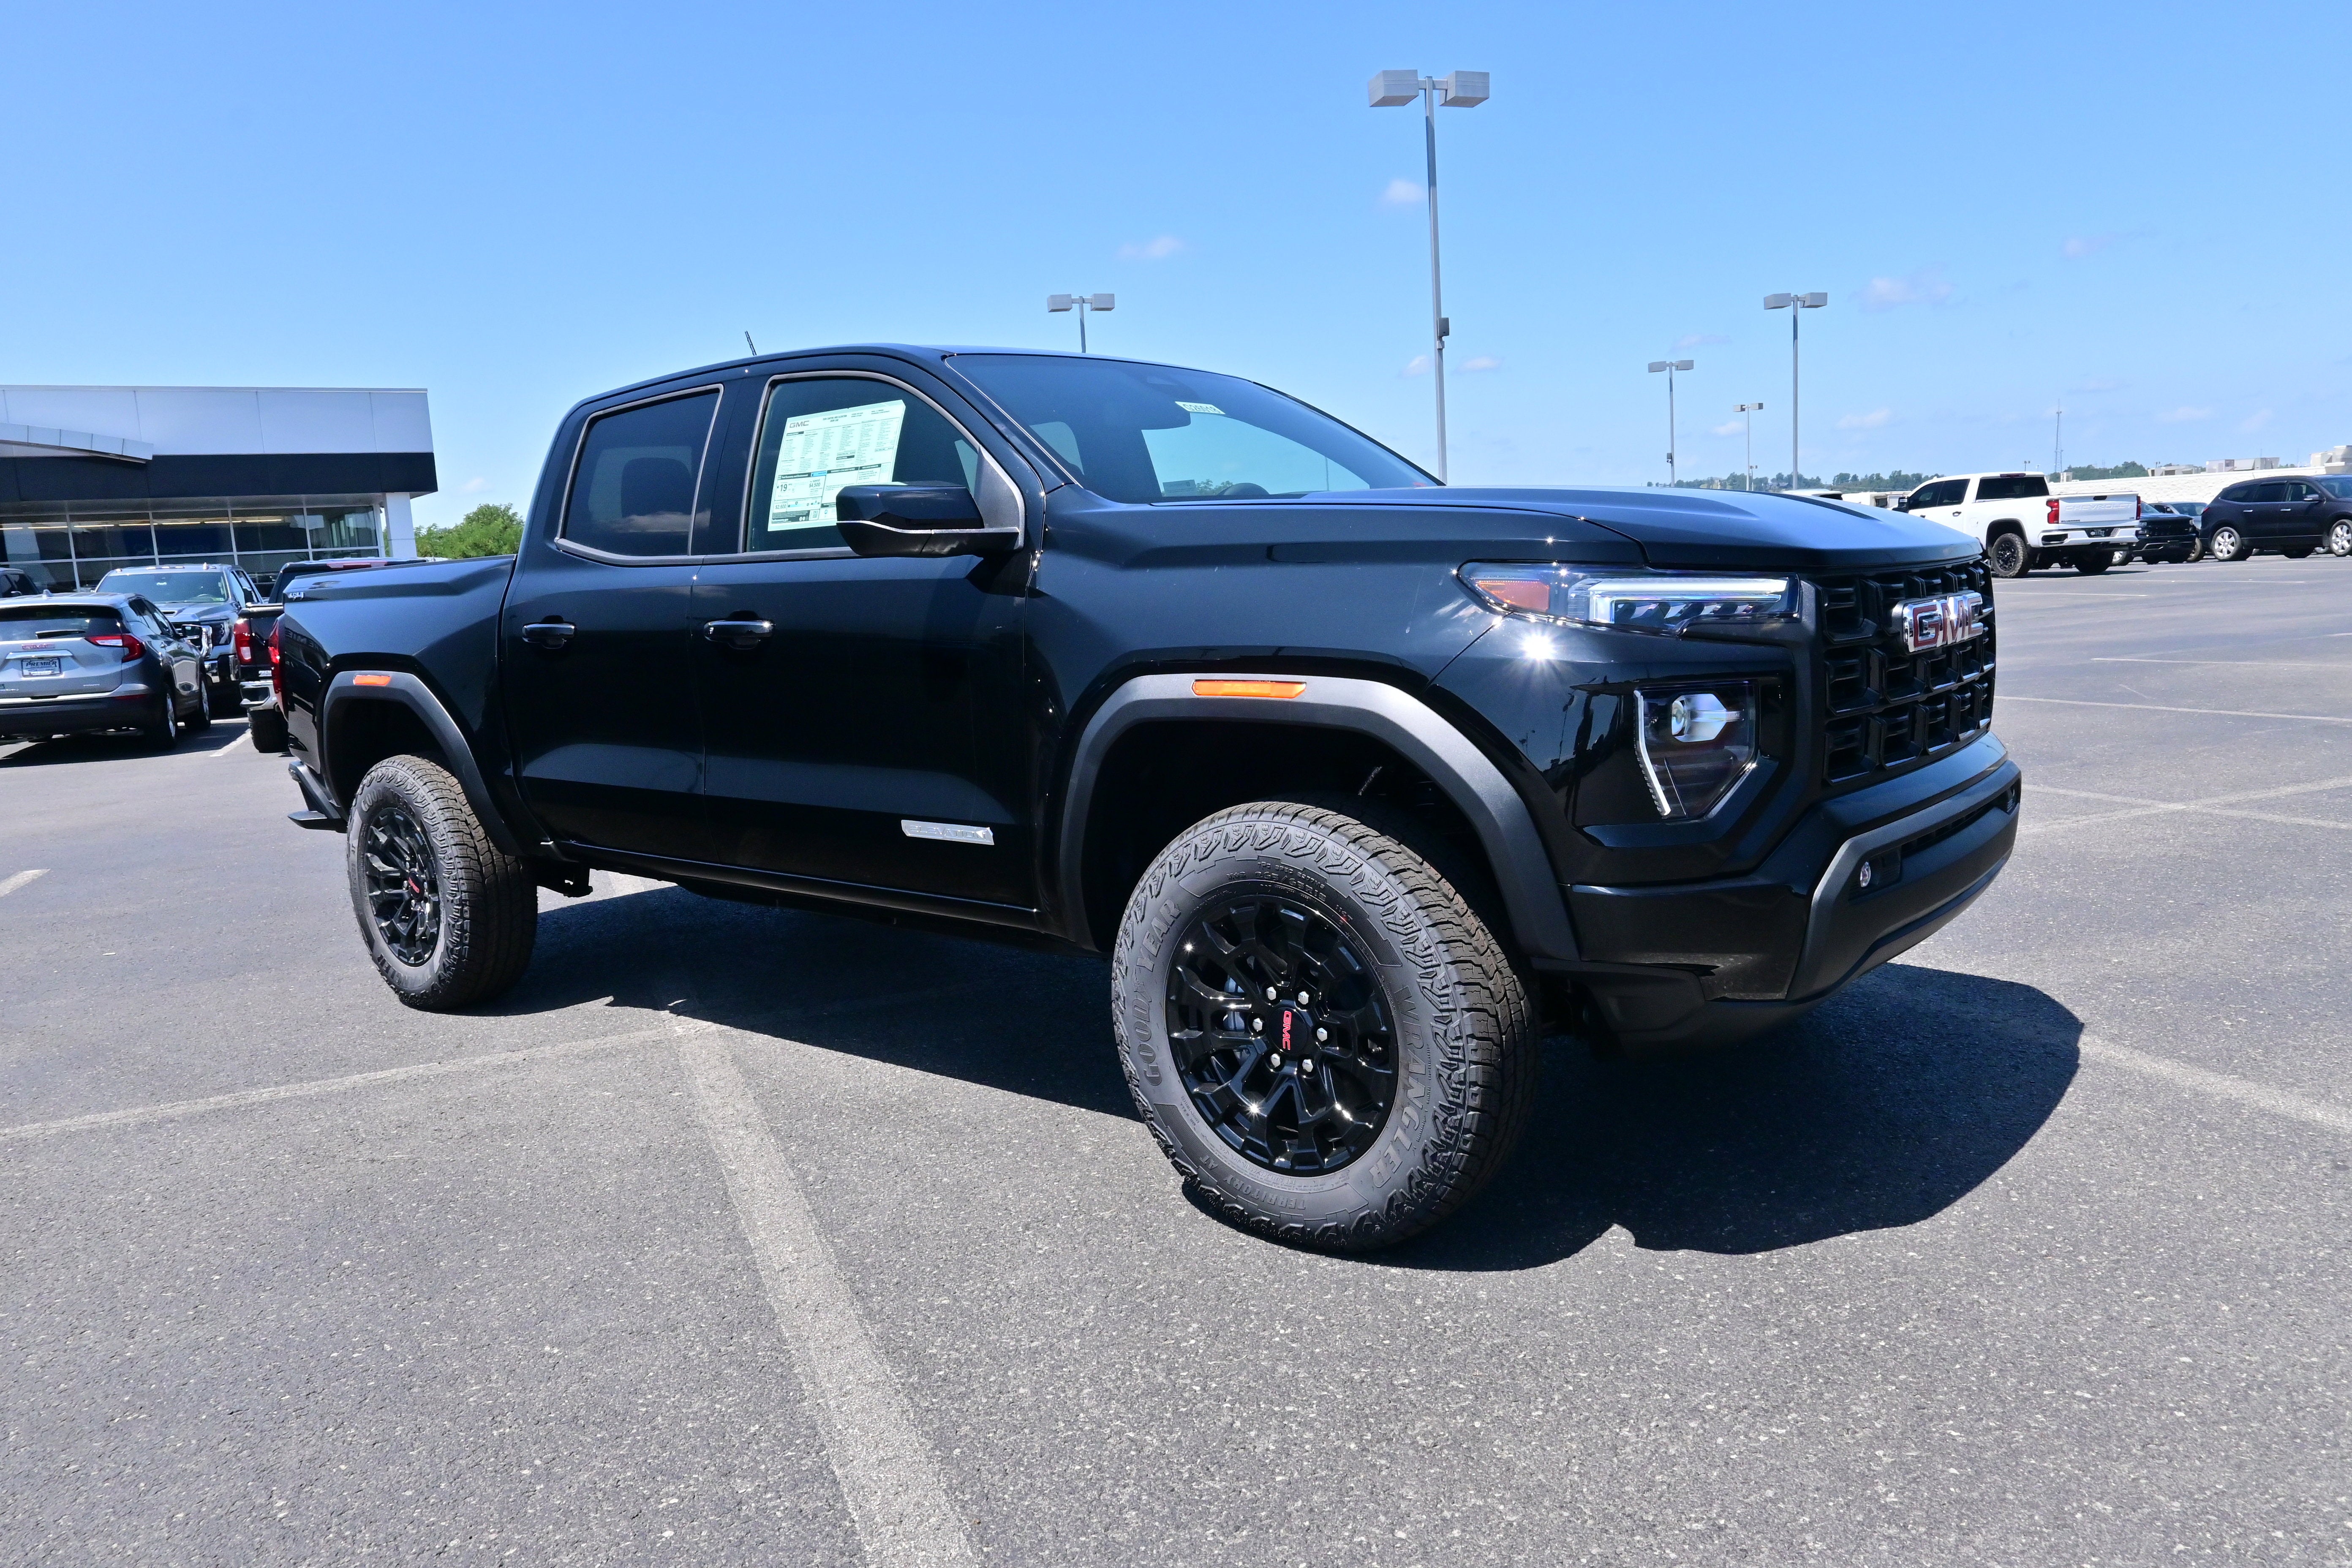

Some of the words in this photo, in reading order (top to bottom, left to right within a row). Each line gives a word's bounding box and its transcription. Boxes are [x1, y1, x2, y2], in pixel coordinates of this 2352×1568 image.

[1903, 592, 1983, 653] GMC
[909, 825, 986, 841] ELEVATION
[1282, 1010, 1292, 1051] GMC
[1369, 985, 1426, 1188] WRANGLER
[1200, 1154, 1218, 1169] AT
[1224, 1175, 1306, 1210] TERRITORY
